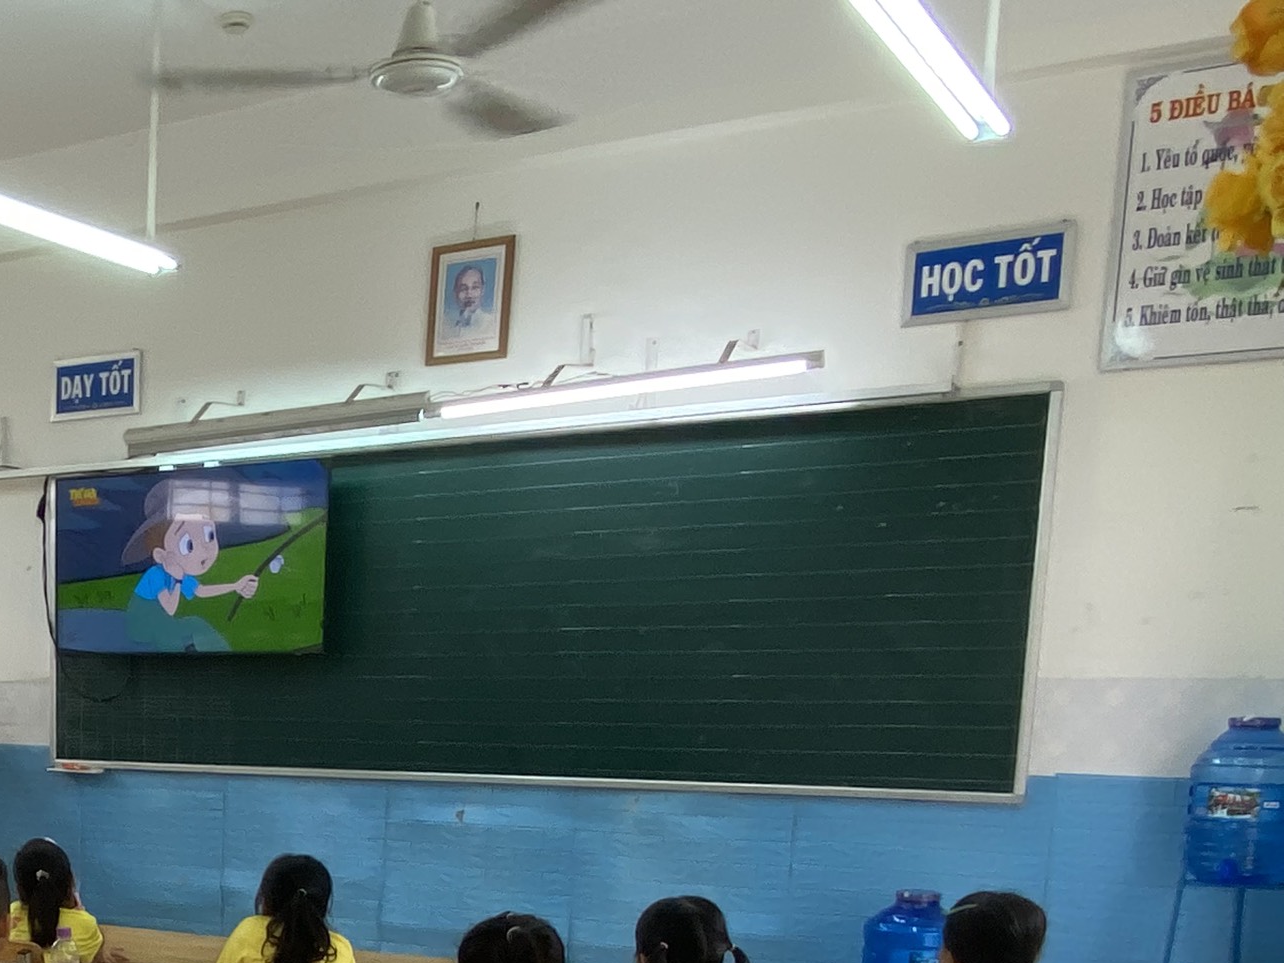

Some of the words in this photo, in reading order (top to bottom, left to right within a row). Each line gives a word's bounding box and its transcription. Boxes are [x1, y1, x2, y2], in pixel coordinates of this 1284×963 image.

[1149, 101, 1163, 123] 5
[1168, 83, 1222, 121] ĐIỀU
[1227, 81, 1257, 111] BÁ
[1141, 152, 1150, 173] 1.
[1156, 148, 1180, 171] Yêu
[1136, 191, 1147, 211] 2.
[1151, 188, 1177, 214] Học
[1181, 185, 1202, 211] tập
[1132, 230, 1142, 250] 3.
[920, 259, 985, 302] HỌC
[994, 237, 1058, 289] TỐT
[1129, 269, 1139, 289] 4.
[1143, 265, 1168, 288] Giữ
[1214, 257, 1243, 281] sinh
[1139, 304, 1181, 327] Khiêm
[1215, 297, 1242, 322] thật
[61, 374, 94, 404] DẠY
[98, 360, 132, 396] TỐT
